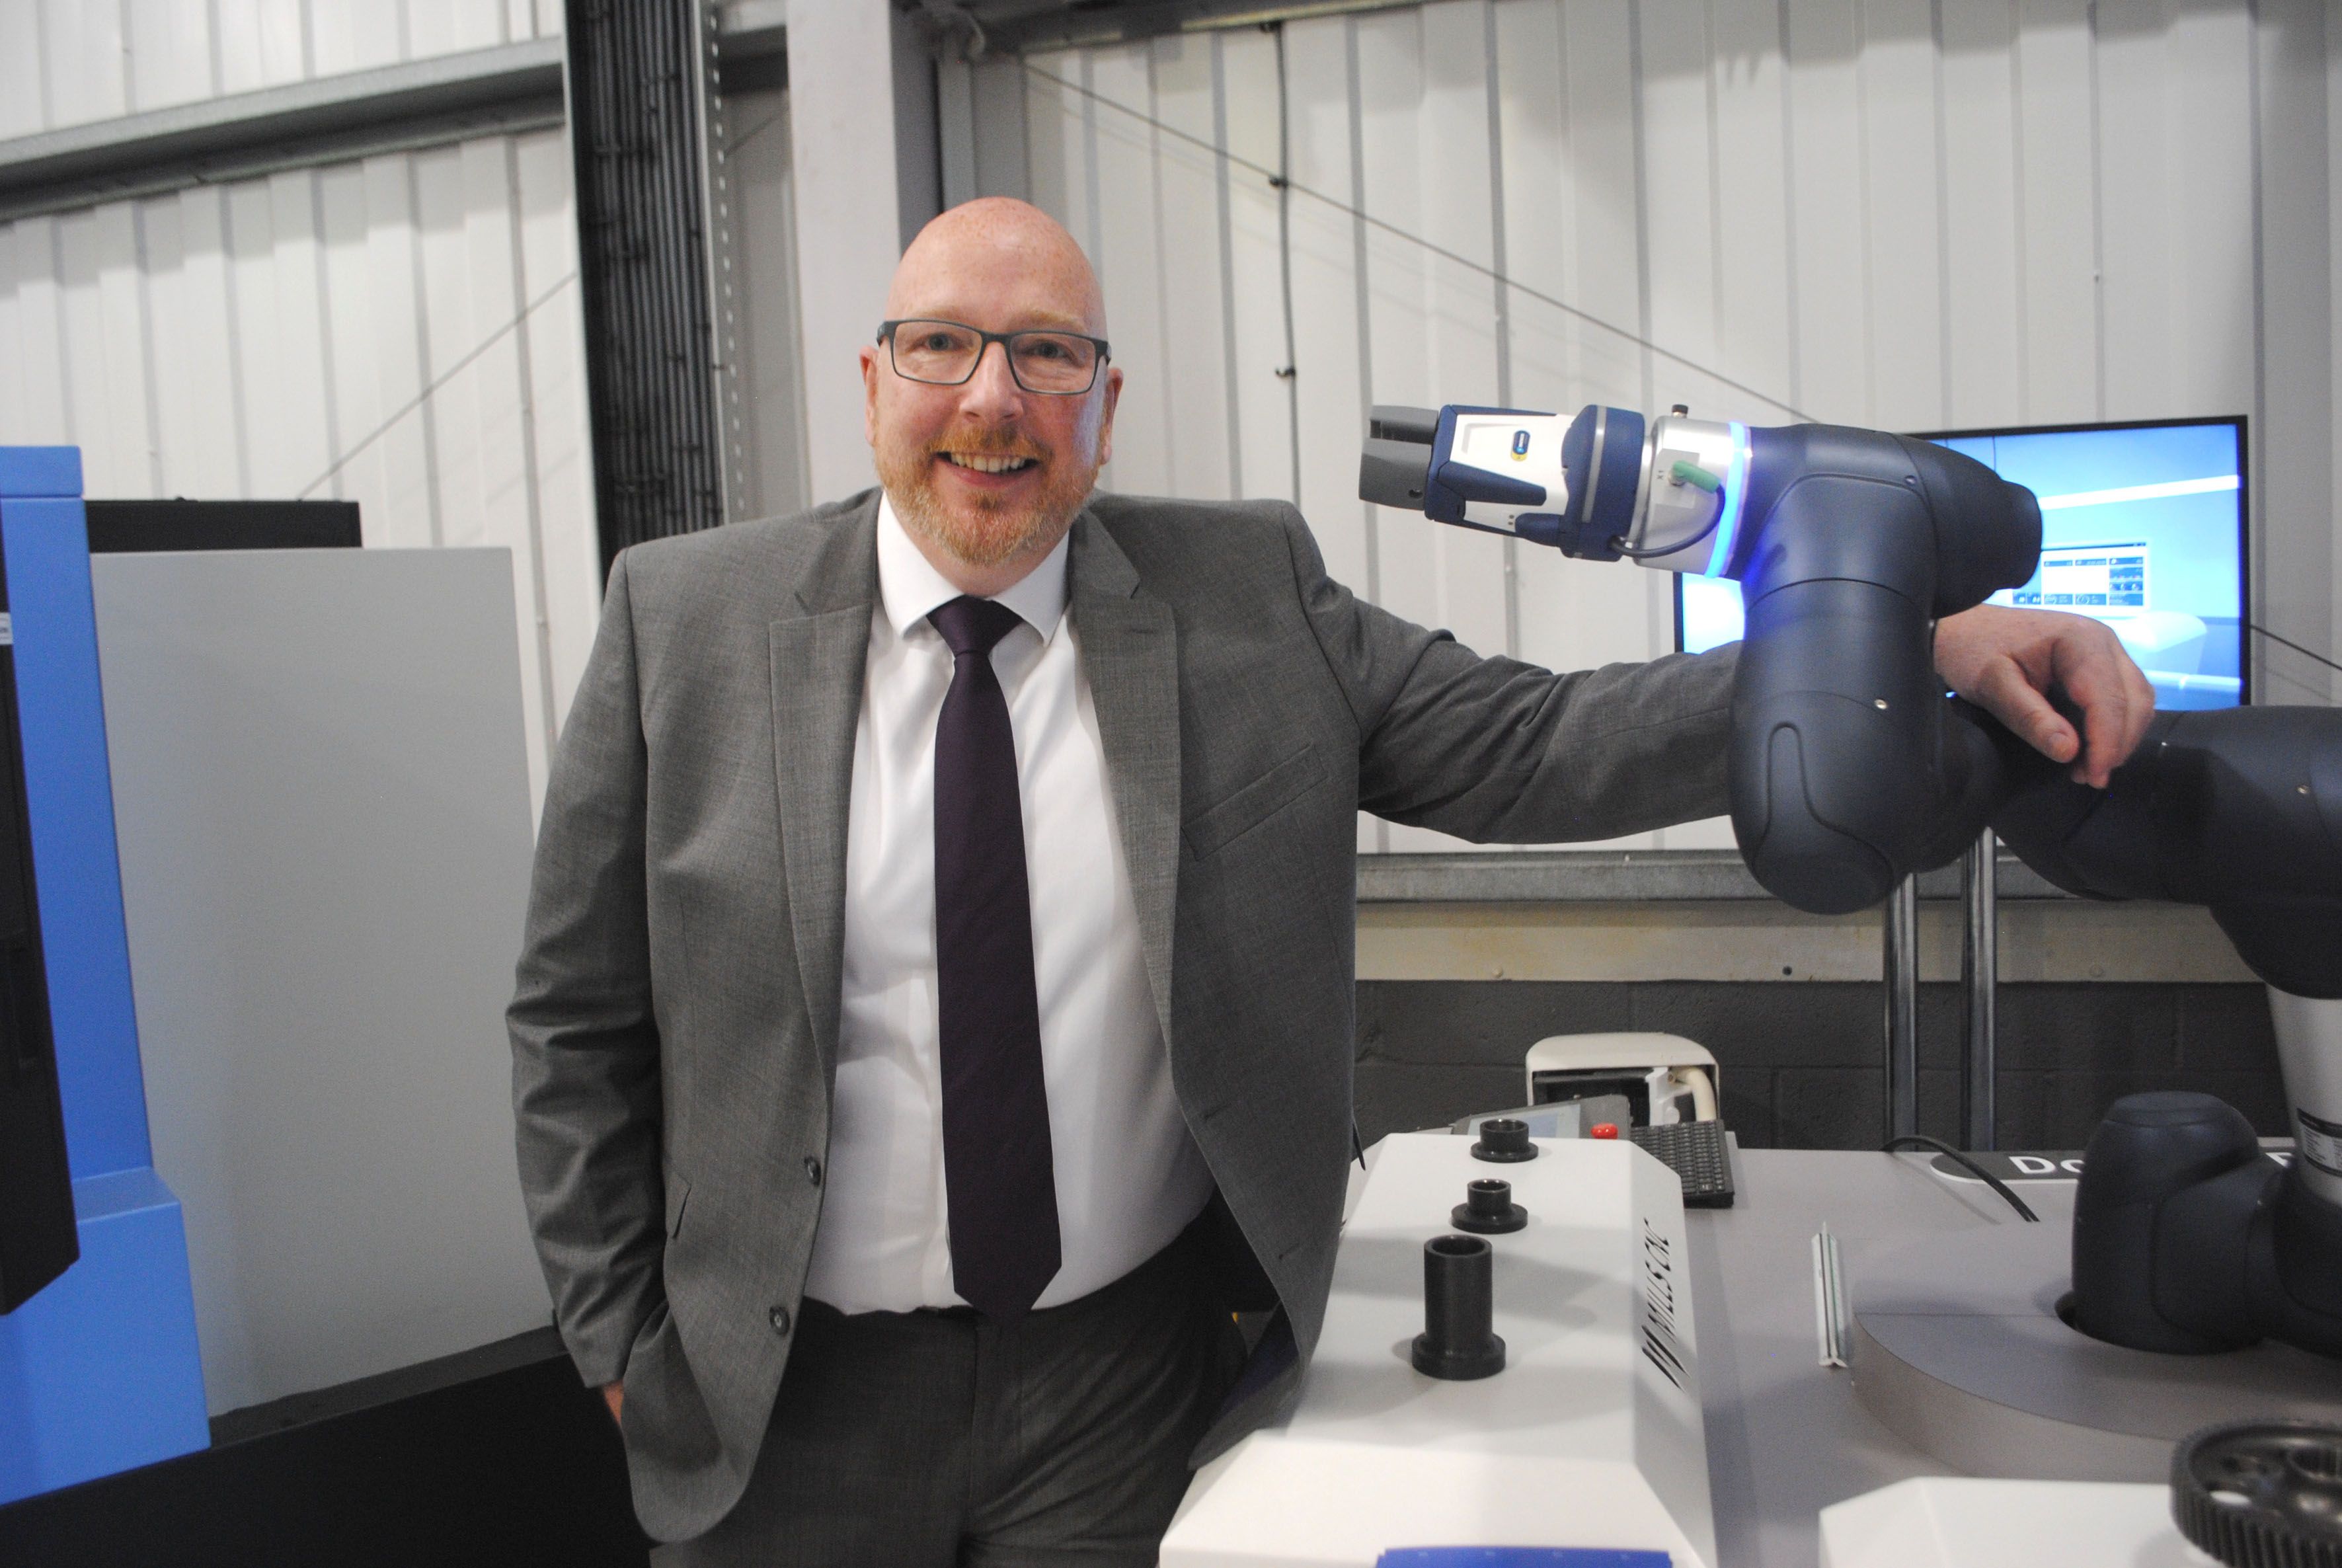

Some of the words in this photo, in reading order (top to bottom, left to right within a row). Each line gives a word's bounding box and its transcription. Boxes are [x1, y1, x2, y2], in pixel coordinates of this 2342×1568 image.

[2009, 1156, 2084, 1173] Do
[1644, 1217, 1671, 1273] CNC
[1646, 1260, 1676, 1345] MILLS
